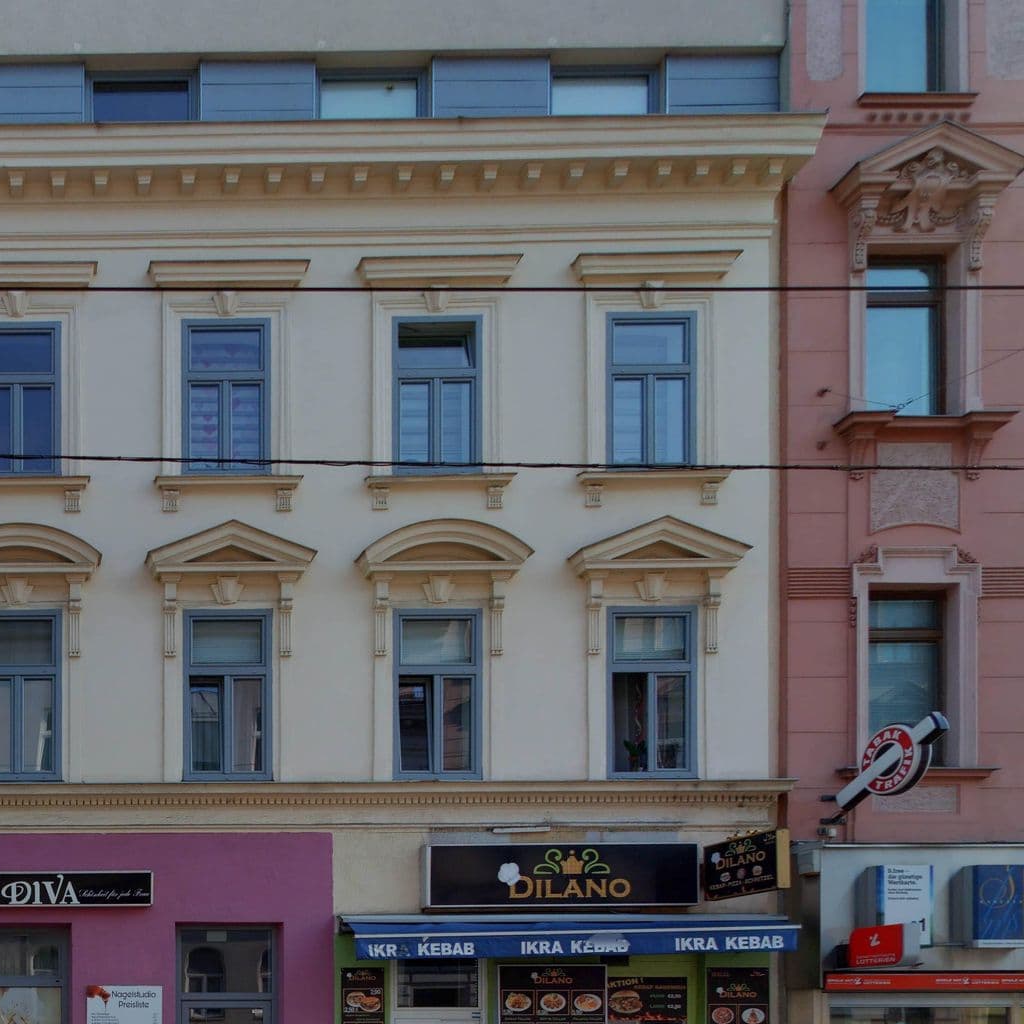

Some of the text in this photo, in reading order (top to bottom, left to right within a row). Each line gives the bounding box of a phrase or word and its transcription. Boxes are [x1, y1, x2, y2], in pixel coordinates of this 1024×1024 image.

[863, 730, 902, 765] TABAK
[876, 747, 913, 790] TRAFIK
[716, 850, 766, 870] DILANO
[1, 874, 80, 905] DIVA
[509, 875, 632, 899] DILANO
[418, 942, 475, 957] KEBAB
[520, 941, 564, 955] IKRA
[675, 935, 786, 952] IKRA KEBAB
[856, 957, 896, 965] LOTTERIEN
[534, 975, 573, 985] DILANO
[111, 991, 157, 1000] Nagelstudio
[719, 990, 758, 998] DILANO
[118, 1001, 150, 1009] Preisliste
